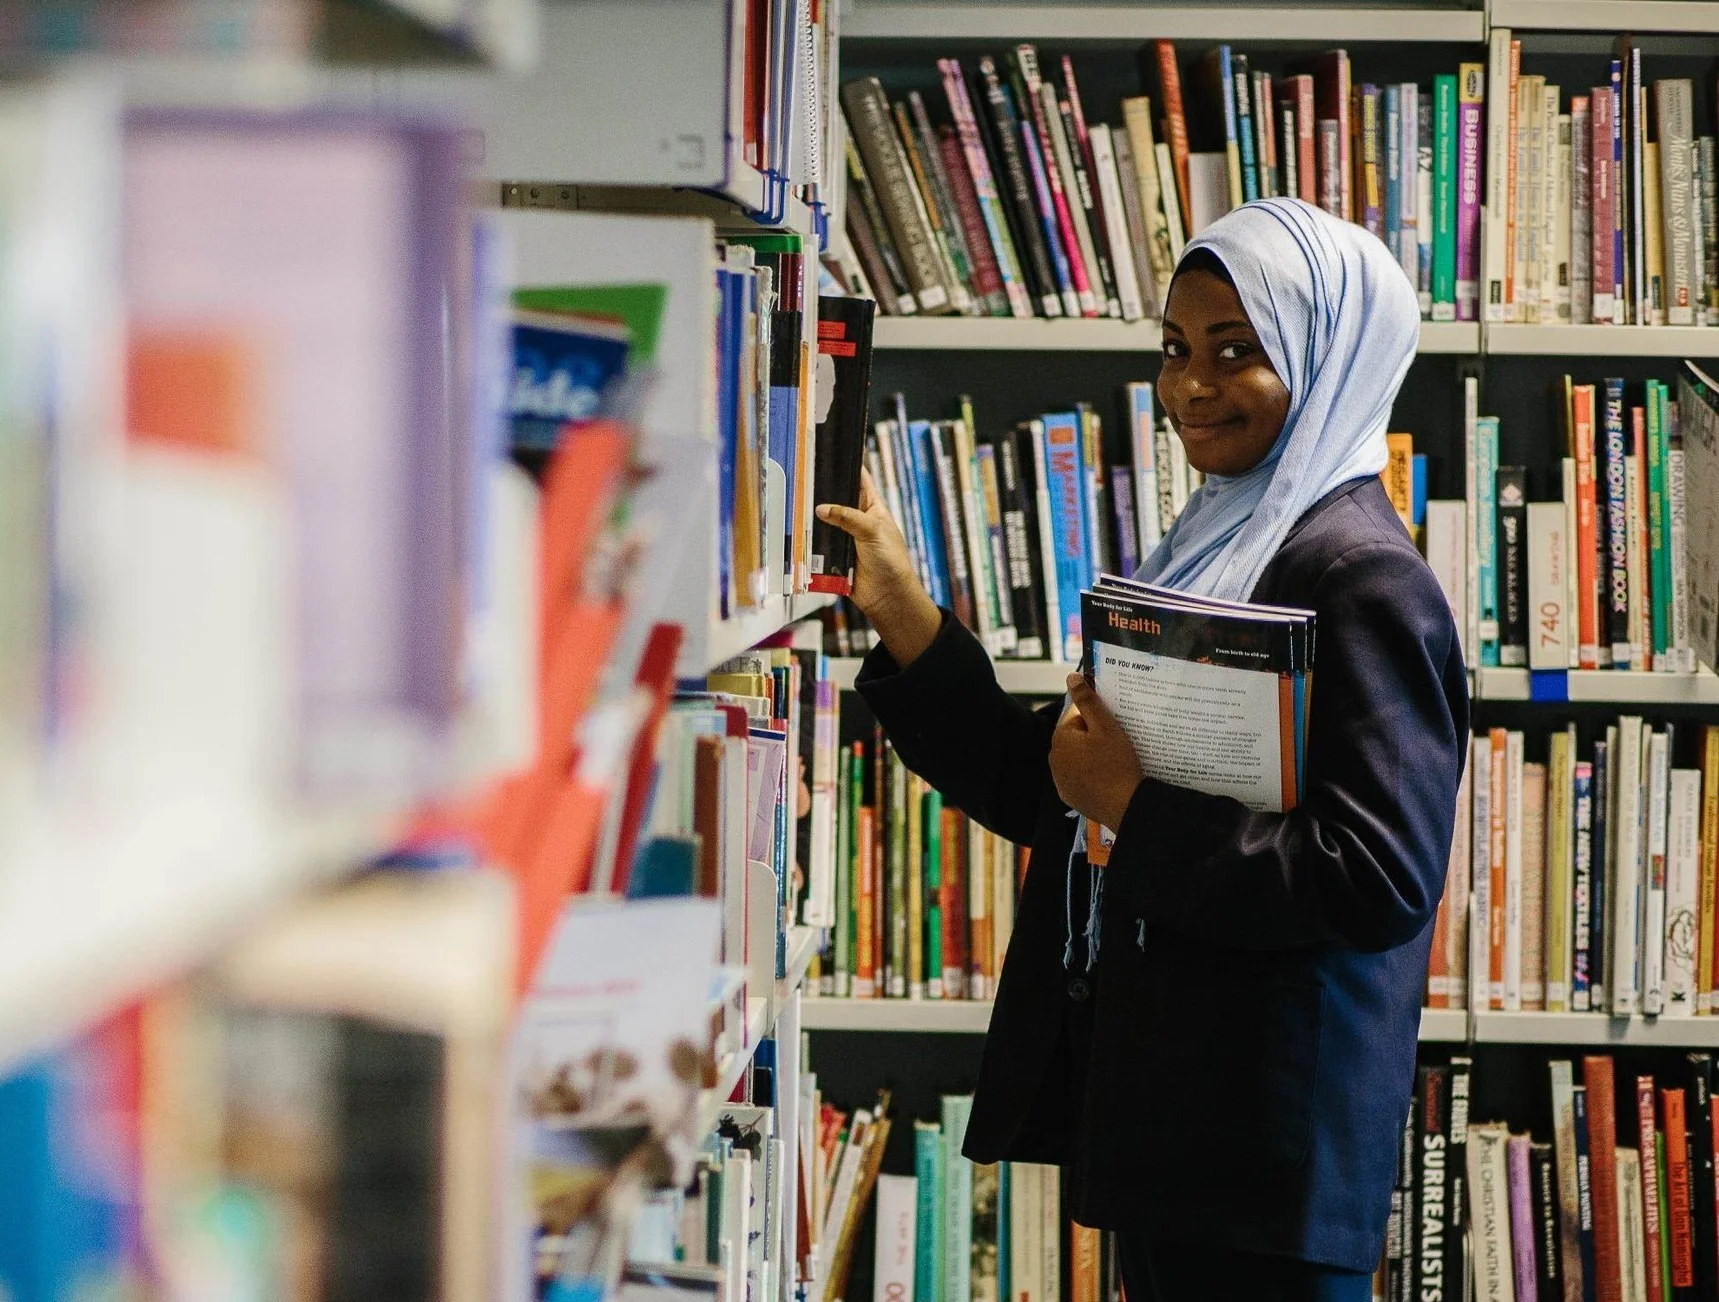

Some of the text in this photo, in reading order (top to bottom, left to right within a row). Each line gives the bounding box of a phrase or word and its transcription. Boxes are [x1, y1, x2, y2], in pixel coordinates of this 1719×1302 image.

[1546, 96, 1555, 110] The
[1464, 109, 1480, 204] BUSINESS
[1670, 179, 1690, 214] Nuns
[1607, 399, 1628, 613] THE LONDON FASHION BOOK
[1671, 453, 1685, 528] DRAWING
[1103, 602, 1115, 610] Body
[1108, 611, 1161, 636] Health
[1540, 602, 1560, 648] 740
[1105, 657, 1155, 672] DID YOU KNOW?
[1706, 795, 1716, 844] Traditional
[1452, 1073, 1470, 1098] THE
[1672, 1161, 1686, 1179] The
[1480, 1169, 1496, 1237] CHRISTIAN
[1672, 1182, 1686, 1198] Art
[1421, 1134, 1445, 1302] SURREALISTS
[1674, 1211, 1688, 1231] Dan
[1485, 1240, 1498, 1276] FAITH
[1675, 1233, 1691, 1284] Namingha
